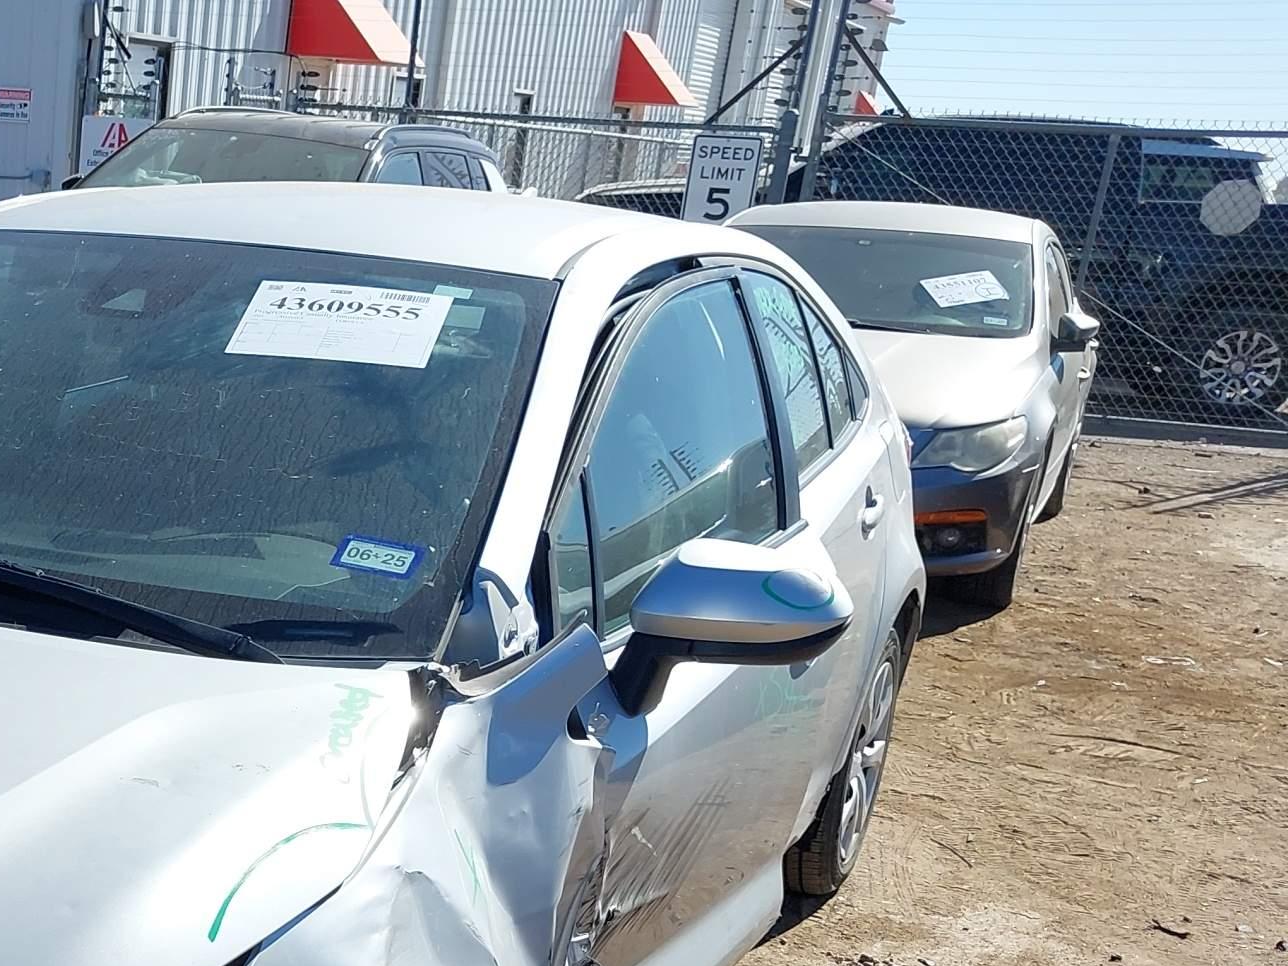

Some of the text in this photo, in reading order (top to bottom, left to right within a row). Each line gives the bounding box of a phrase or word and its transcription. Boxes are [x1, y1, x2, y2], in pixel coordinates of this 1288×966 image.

[698, 145, 755, 161] SPEED
[700, 166, 746, 181] LIMIT
[703, 187, 731, 221] 5
[269, 296, 423, 321] 43609555
